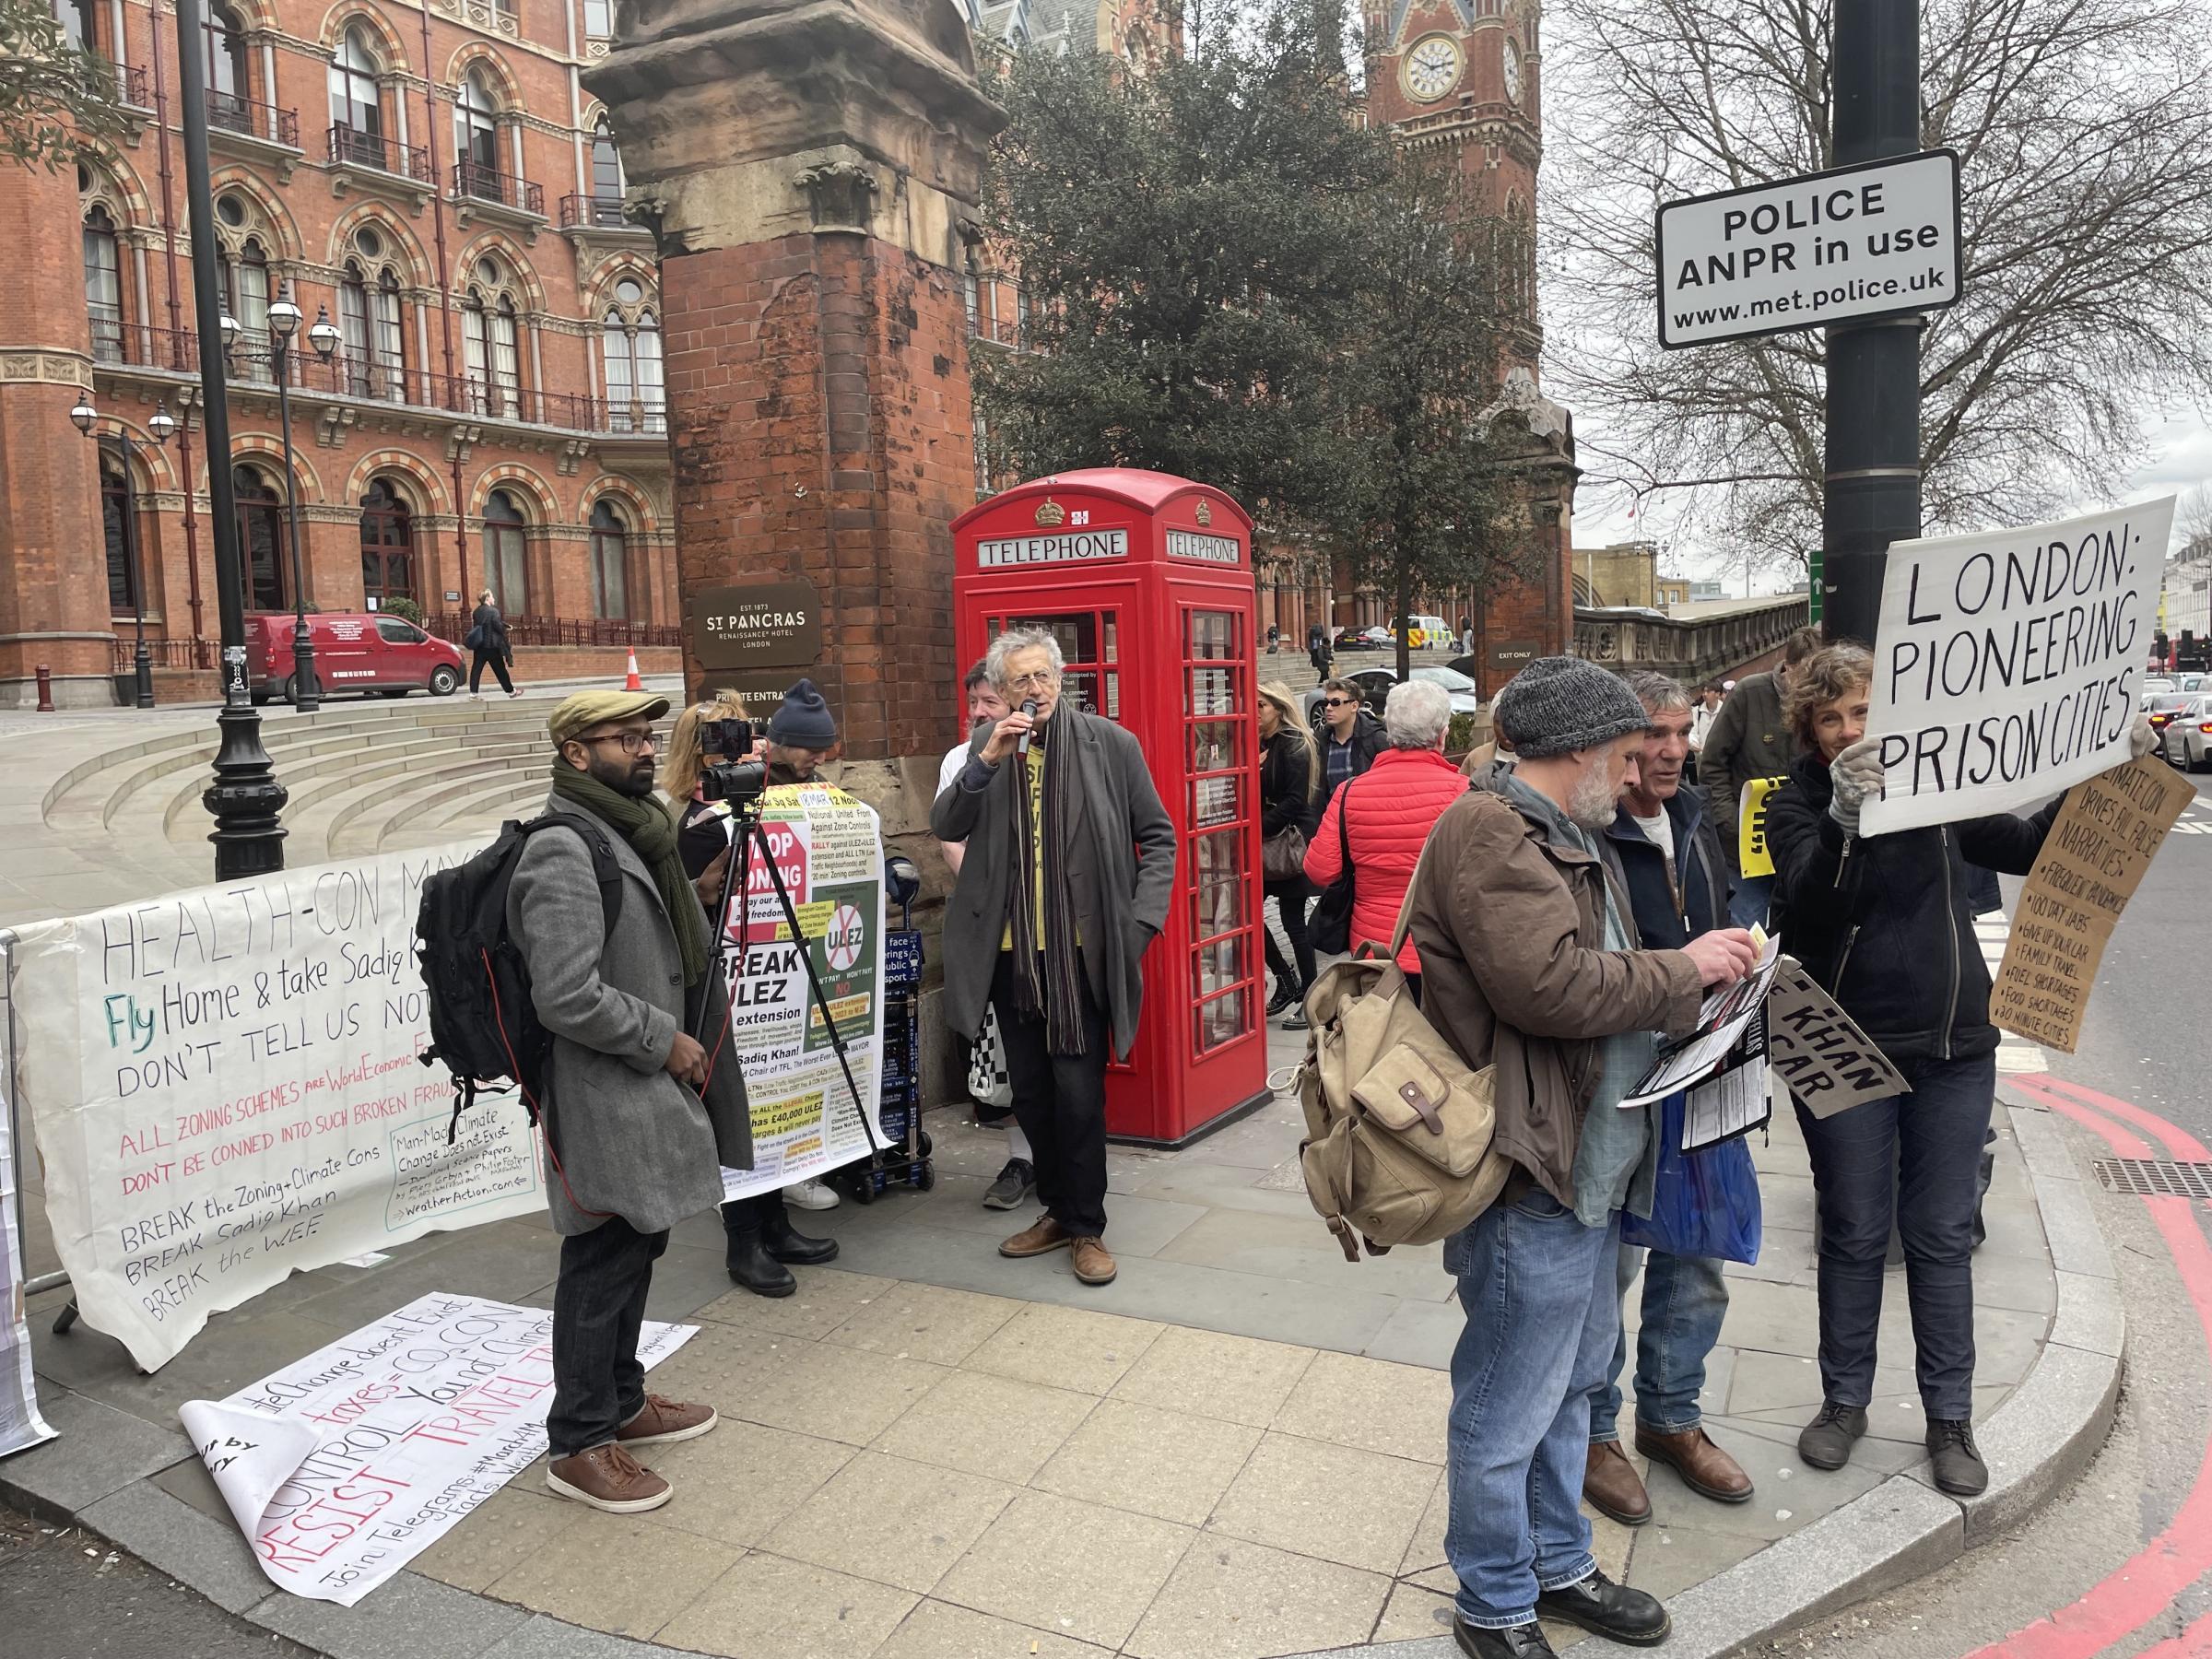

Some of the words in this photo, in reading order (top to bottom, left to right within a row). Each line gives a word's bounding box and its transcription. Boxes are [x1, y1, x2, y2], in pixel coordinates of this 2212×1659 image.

[1724, 182, 1885, 241] POLICE
[1676, 241, 1797, 290] ANPR
[1814, 236, 1849, 266] in
[1866, 224, 1939, 256] use
[1673, 266, 1946, 329] www.met.police.uk
[982, 533, 1123, 564] TELEPHONE
[1167, 532, 1236, 561] TELEPHONE
[1907, 523, 2140, 626] LONDON:
[729, 611, 806, 629] PANCRAS
[1890, 590, 2138, 705] PIONEERING
[716, 692, 752, 702] PRITE
[753, 691, 787, 701] ENTRA
[1878, 701, 2048, 802] PRISON
[2050, 666, 2134, 767] CITIES
[2101, 763, 2149, 803] IMATE
[2139, 780, 2169, 816] CON
[2079, 785, 2119, 826] DRIVES
[2128, 820, 2164, 858] FALSE
[748, 831, 794, 859] TOP
[811, 841, 830, 850] RALLY
[759, 897, 773, 905] our
[2030, 894, 2049, 916] 100
[2065, 909, 2091, 933] JABS
[102, 865, 379, 985] HEALTH-CON
[829, 926, 863, 948] ULEZ
[889, 937, 909, 947] face
[2022, 923, 2043, 943] GIVE
[2071, 943, 2089, 964] CAR
[719, 949, 799, 980] BREAK
[886, 962, 907, 971] ublic
[2019, 944, 2053, 967] FAMILY
[2053, 955, 2080, 981] TRAVEL
[103, 994, 155, 1054] Fly
[162, 982, 241, 1035] Home
[254, 971, 272, 1009] &
[276, 957, 328, 1001] take
[340, 936, 404, 985] Sadiq
[735, 979, 788, 1007] LEZ
[835, 982, 852, 996] NO
[2009, 966, 2031, 986] FUEL
[2033, 972, 2080, 1004] SHORTAGES
[736, 1007, 801, 1027] extension
[2005, 986, 2026, 1006] FOOD
[2028, 996, 2076, 1024] SHORTAGES
[2012, 1010, 2042, 1032] MINUTE
[2042, 1021, 2069, 1046] CITIES
[117, 1041, 222, 1098] DON'T
[241, 1017, 313, 1063] TELL
[326, 1002, 360, 1041] US
[737, 1053, 768, 1065] Sadiq
[771, 1045, 800, 1061] Khan!
[749, 1067, 769, 1077] Chair
[770, 1065, 778, 1074] of
[803, 1056, 819, 1066] Worst
[819, 1053, 831, 1062] Ever
[851, 1041, 869, 1052] MAYOR
[1771, 1034, 1835, 1099] CAR
[1782, 1005, 1886, 1091] KHAN
[120, 1124, 171, 1159] ALL
[176, 1105, 232, 1142] ZONING
[235, 1080, 300, 1123] SCHEMES
[305, 1076, 325, 1095] ARE
[393, 1123, 449, 1151] 'Man-Mad
[456, 1108, 499, 1135] Climate
[752, 1118, 769, 1127] has
[771, 1107, 803, 1124] £40,000
[805, 1101, 824, 1114] ULEZ
[794, 1118, 811, 1128] never
[812, 1114, 822, 1124] pay
[183, 1151, 206, 1177] BE
[211, 1133, 275, 1167] CONNED
[281, 1120, 312, 1144] INTO
[315, 1108, 348, 1135] SUCH
[354, 1091, 406, 1125] BROKEN
[398, 1148, 439, 1173] Change
[442, 1141, 465, 1159] Does
[465, 1133, 484, 1150] not
[120, 1201, 196, 1254] BREAK
[204, 1197, 235, 1219] the
[347, 1146, 381, 1168] Cons
[125, 1232, 204, 1287] BREAK
[217, 1209, 275, 1244] Sadiq
[279, 1189, 337, 1225] Khan
[142, 1263, 210, 1323] BREAK
[218, 1245, 255, 1274] the
[265, 1359, 365, 1398] Change
[393, 1300, 473, 1325] Exist
[300, 1382, 400, 1425] taxes
[439, 1304, 524, 1346] CON
[224, 1436, 260, 1451] by
[262, 1419, 422, 1519] CONTROL
[394, 1381, 473, 1406] You
[455, 1357, 507, 1382] not
[491, 1437, 550, 1475] Weathe
[254, 1465, 411, 1573] RESIST
[400, 1376, 554, 1445] TRAVEL
[319, 1550, 387, 1588] Join
